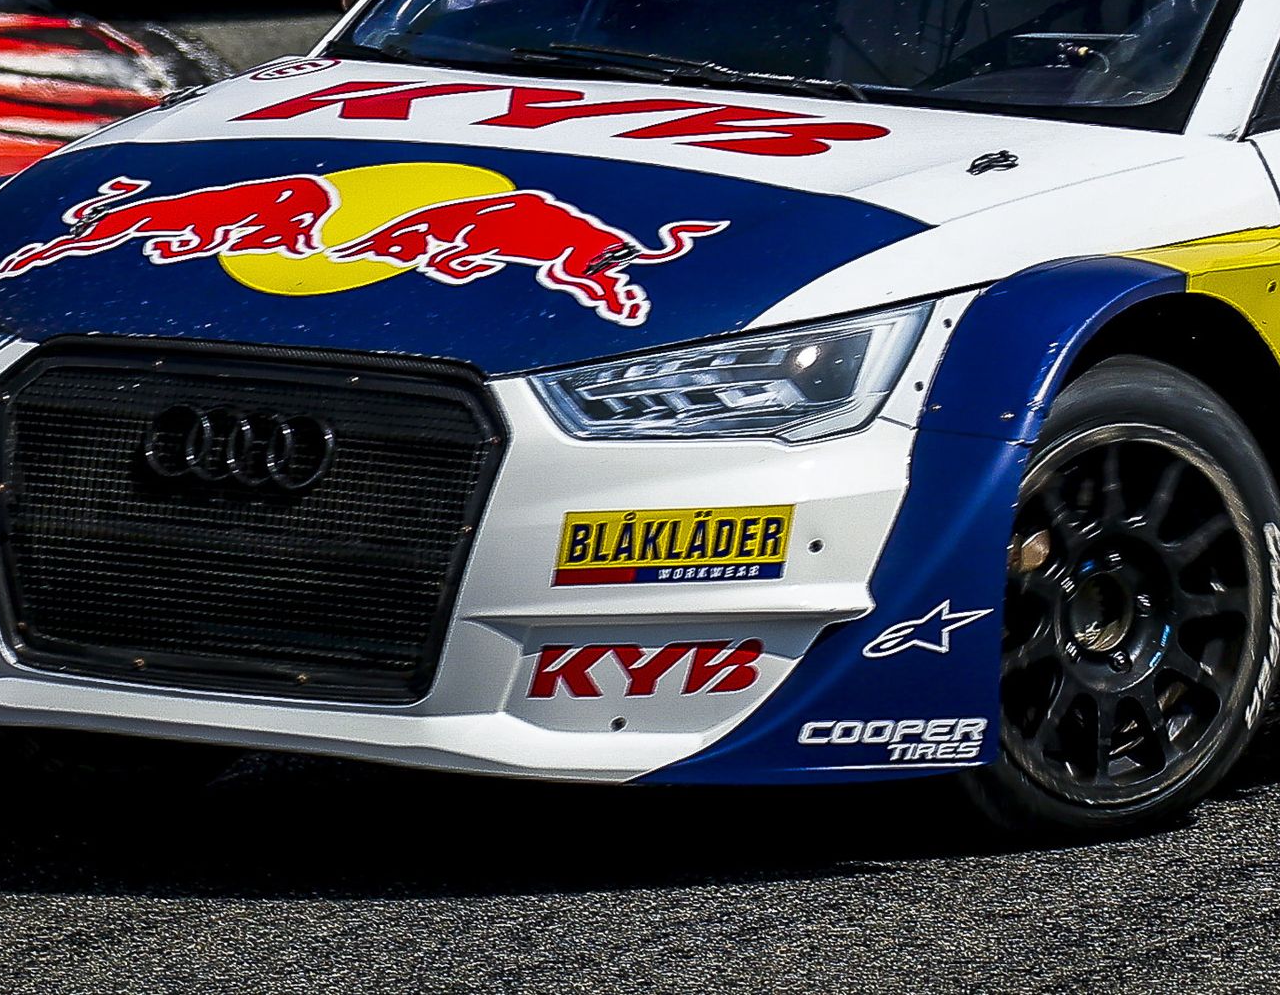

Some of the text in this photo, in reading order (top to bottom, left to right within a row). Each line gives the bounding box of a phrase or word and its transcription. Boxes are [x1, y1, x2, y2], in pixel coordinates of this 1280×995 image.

[227, 81, 892, 157] KYB
[567, 510, 785, 564] BLÅKLÄDER
[658, 564, 760, 580] WORKWEAR
[527, 637, 765, 699] KYB
[798, 717, 987, 745] COOPER
[887, 740, 980, 762] TIRES
